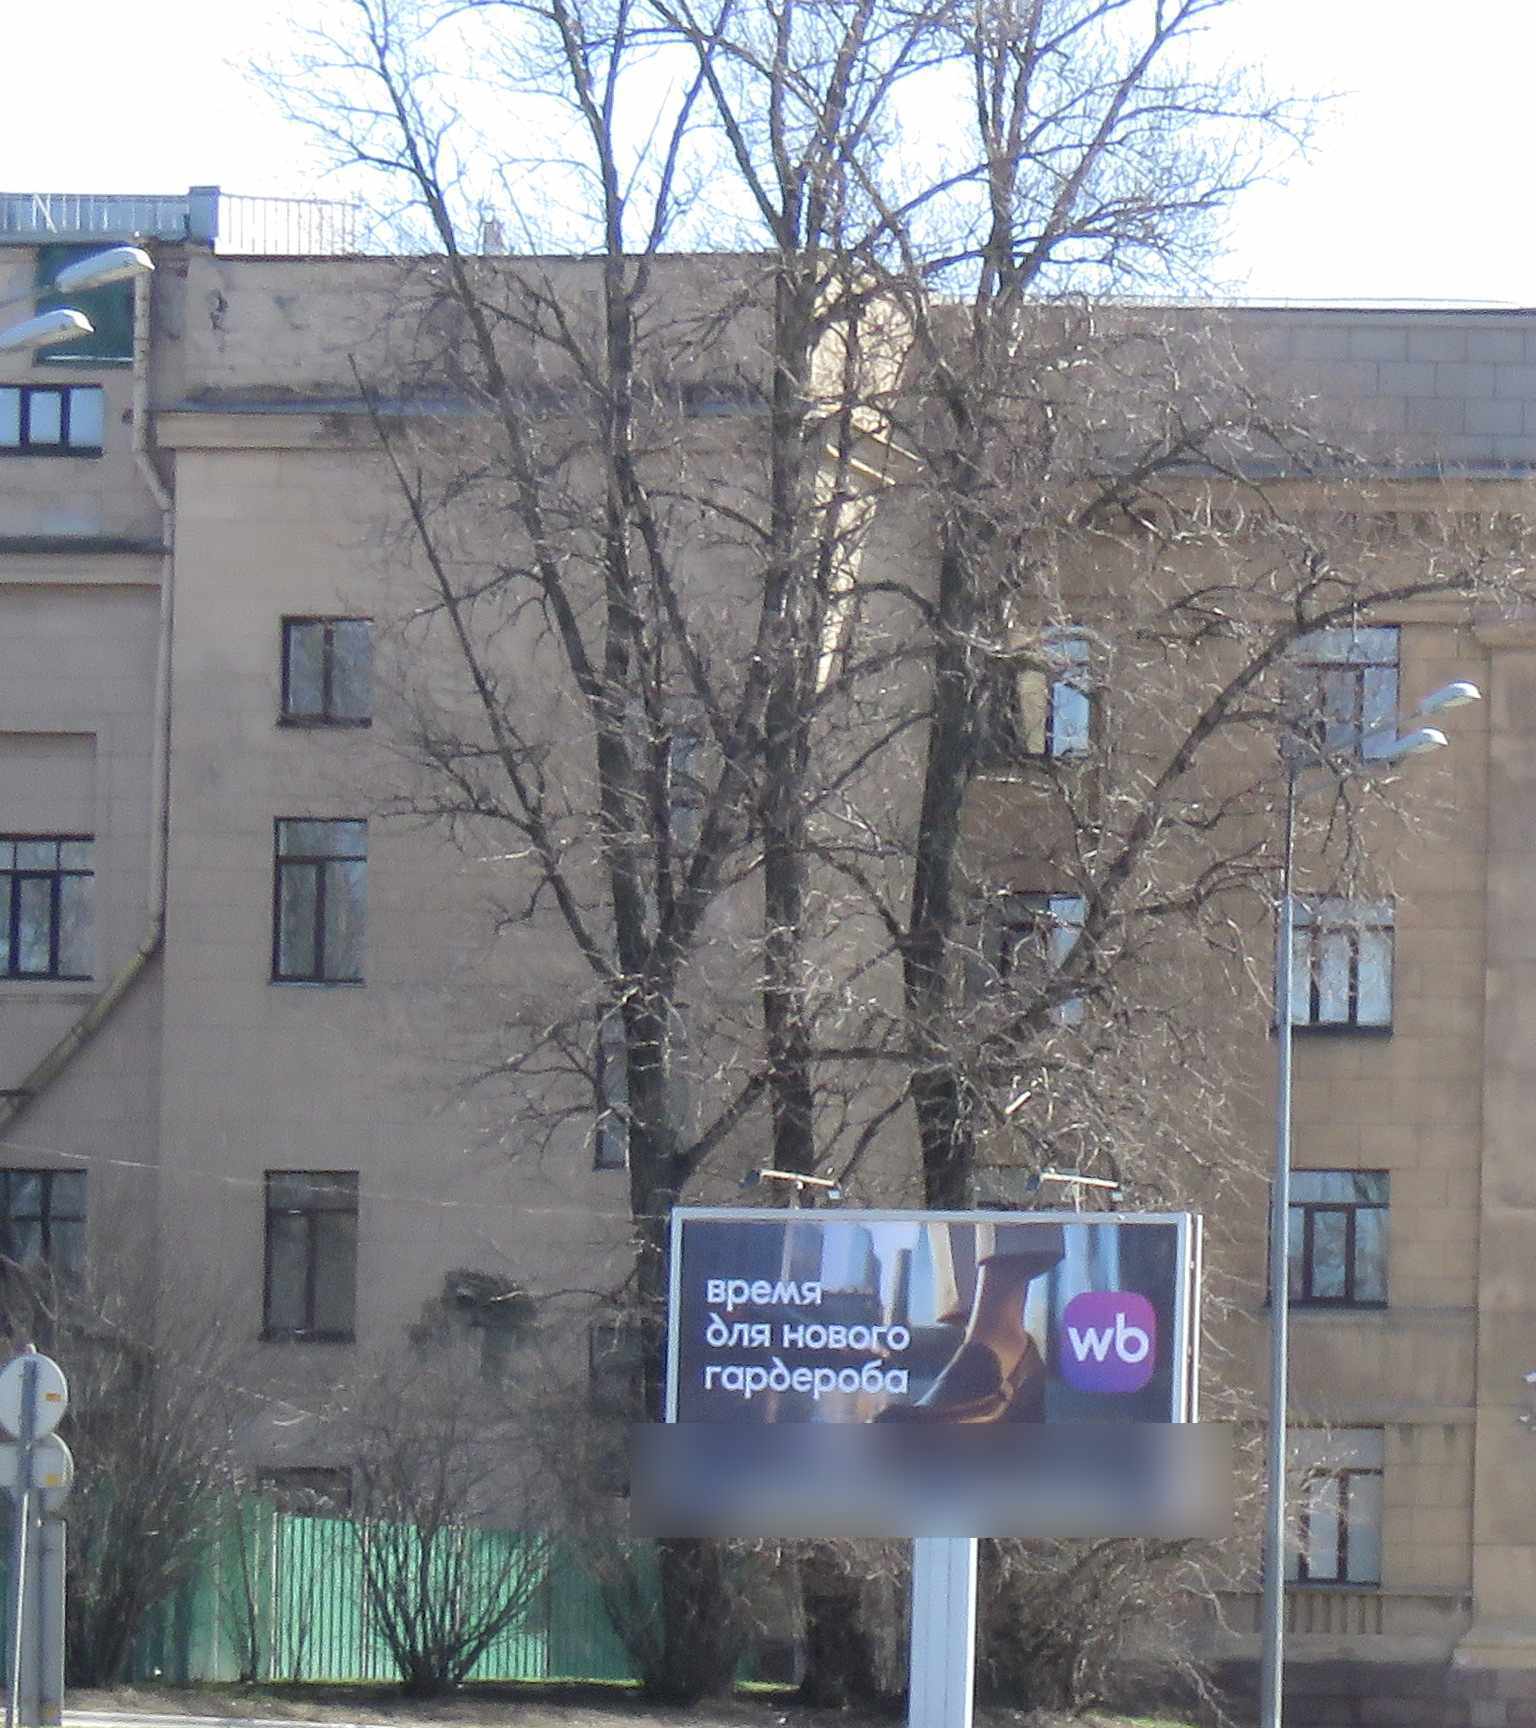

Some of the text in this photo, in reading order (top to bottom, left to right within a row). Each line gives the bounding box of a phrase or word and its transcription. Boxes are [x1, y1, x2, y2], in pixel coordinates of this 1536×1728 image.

[706, 1278, 822, 1311] время
[705, 1313, 911, 1352] для нового
[1068, 1312, 1150, 1364] wb
[704, 1357, 909, 1399] гардероба
